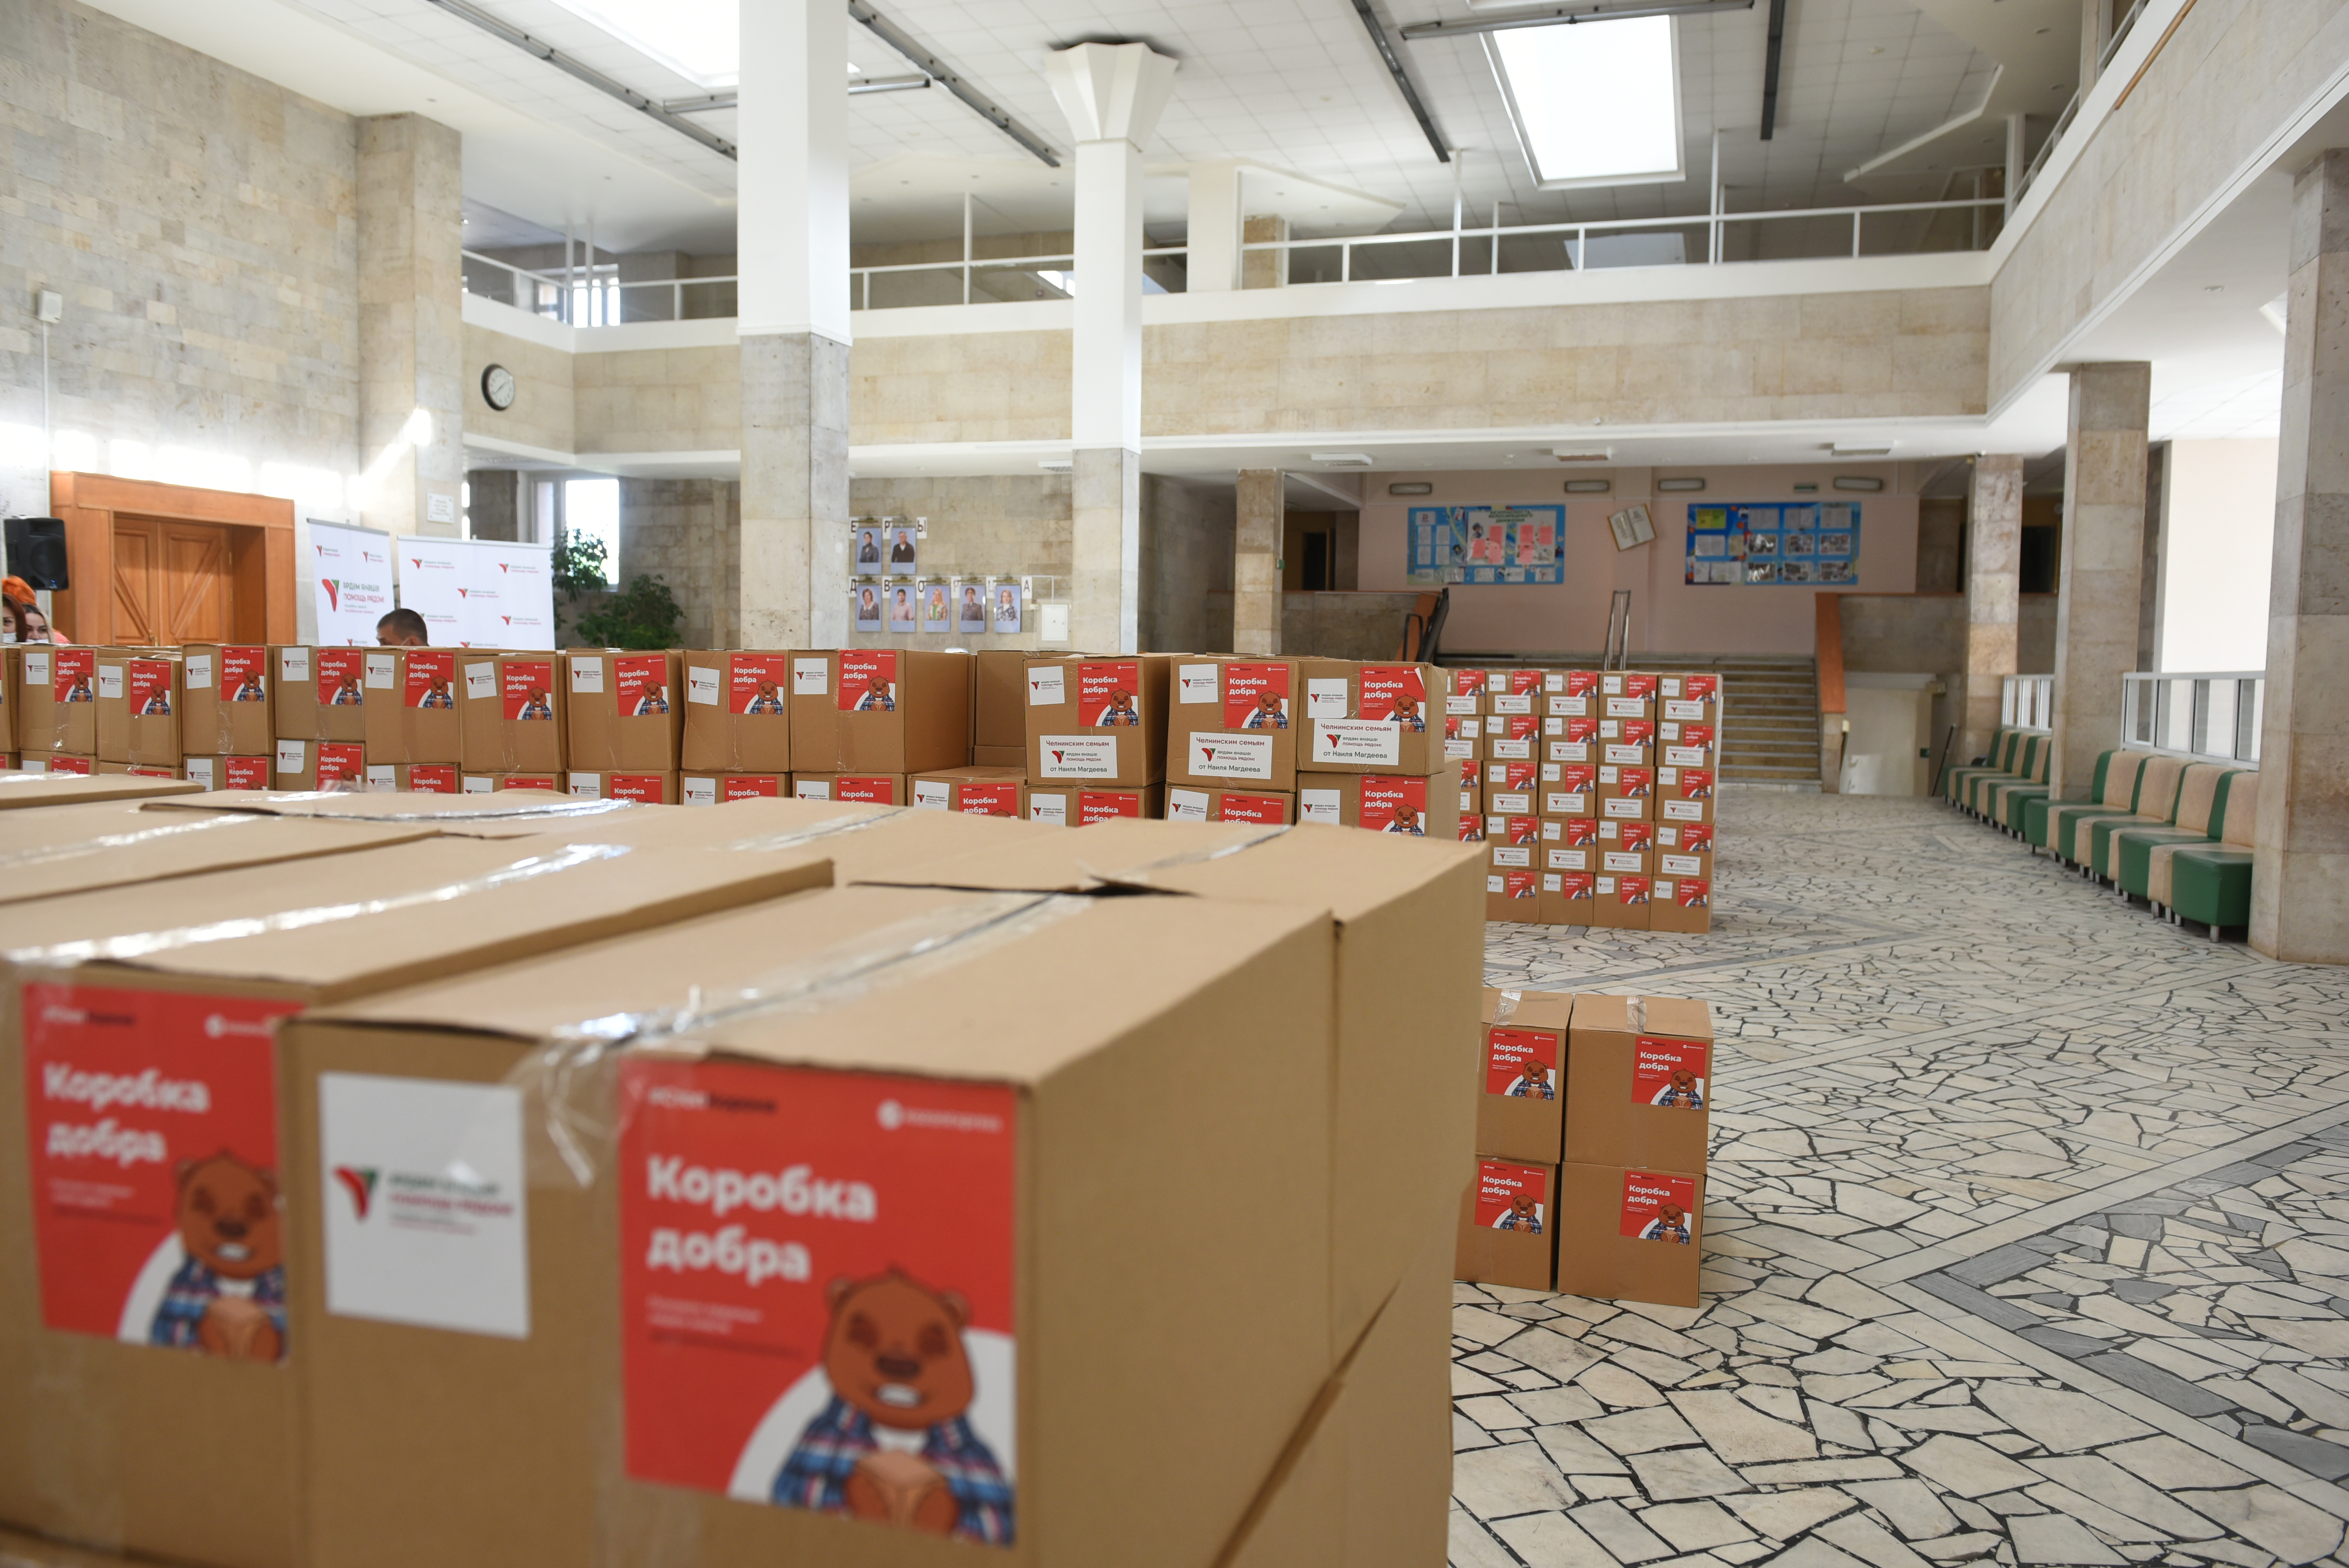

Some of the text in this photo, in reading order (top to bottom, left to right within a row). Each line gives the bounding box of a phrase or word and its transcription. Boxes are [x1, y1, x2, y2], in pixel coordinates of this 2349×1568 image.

[619, 669, 649, 679] Коробка
[619, 679, 642, 688] добра
[1083, 676, 1118, 684] Коробка
[1083, 686, 1109, 695] добра
[1364, 691, 1392, 699] добра
[1365, 790, 1403, 798] Коробка
[963, 797, 997, 805] Коробка
[1365, 800, 1393, 809] добра
[1084, 805, 1118, 813] Коробка
[1225, 808, 1262, 818] Коробка
[1494, 1042, 1533, 1054] Коробка
[1493, 1053, 1522, 1064] добра
[1640, 1051, 1682, 1063] Коробка
[1639, 1062, 1670, 1072] добра
[1483, 1175, 1522, 1188] Коробка
[646, 1154, 878, 1222] Коробка
[1481, 1185, 1511, 1197] добра
[1629, 1185, 1670, 1197] Коробка
[1627, 1195, 1658, 1206] добра
[646, 1224, 811, 1287] добра
